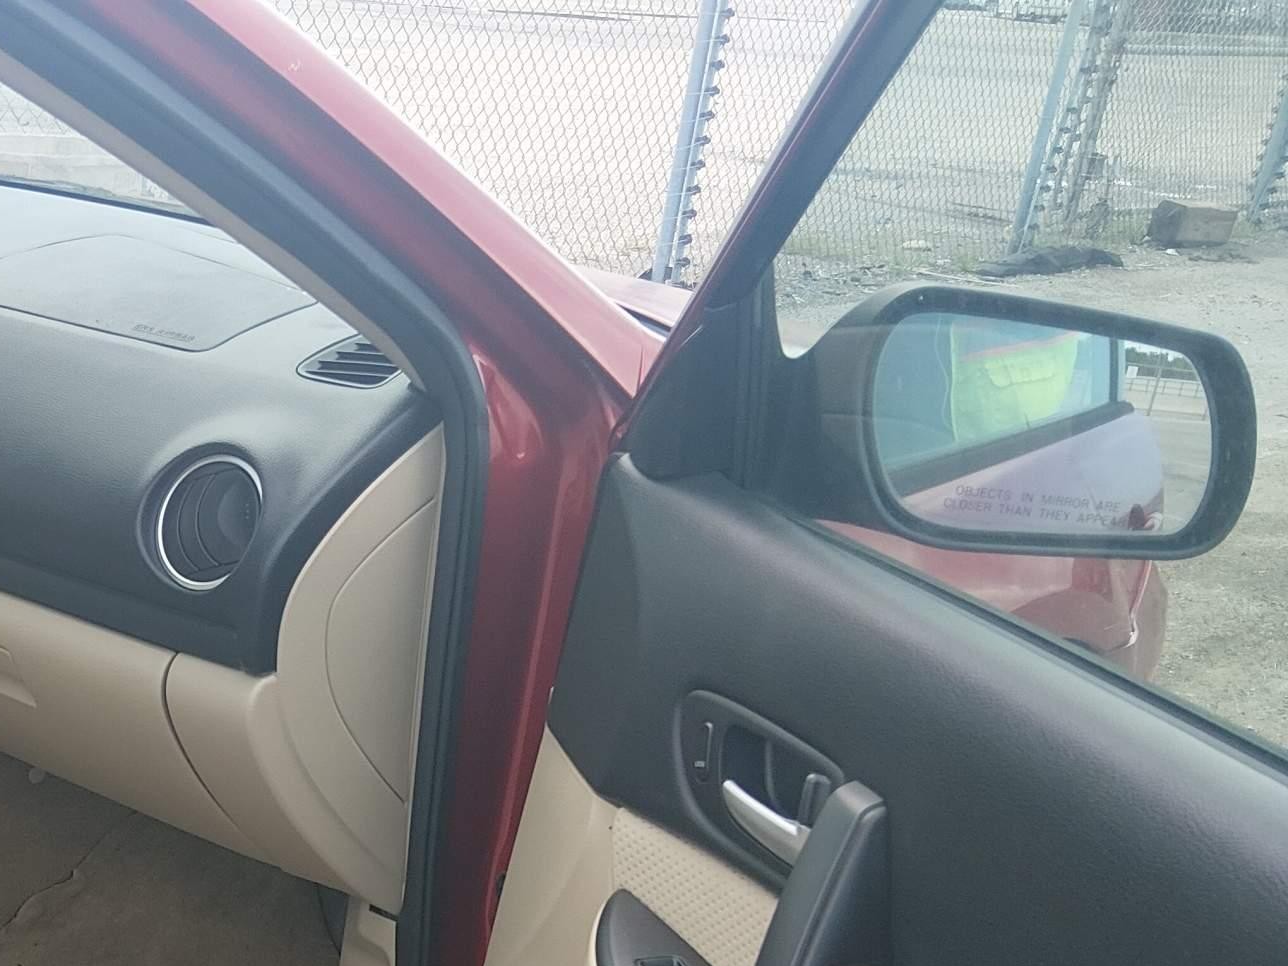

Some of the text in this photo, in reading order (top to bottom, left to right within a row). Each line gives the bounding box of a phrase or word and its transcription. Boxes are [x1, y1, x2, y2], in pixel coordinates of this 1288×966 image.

[943, 497, 992, 513] CLOSER
[998, 503, 1033, 517] THAN
[1039, 507, 1071, 521] THEY
[955, 484, 1121, 513] OBJECTS IN MIRROR ARE
